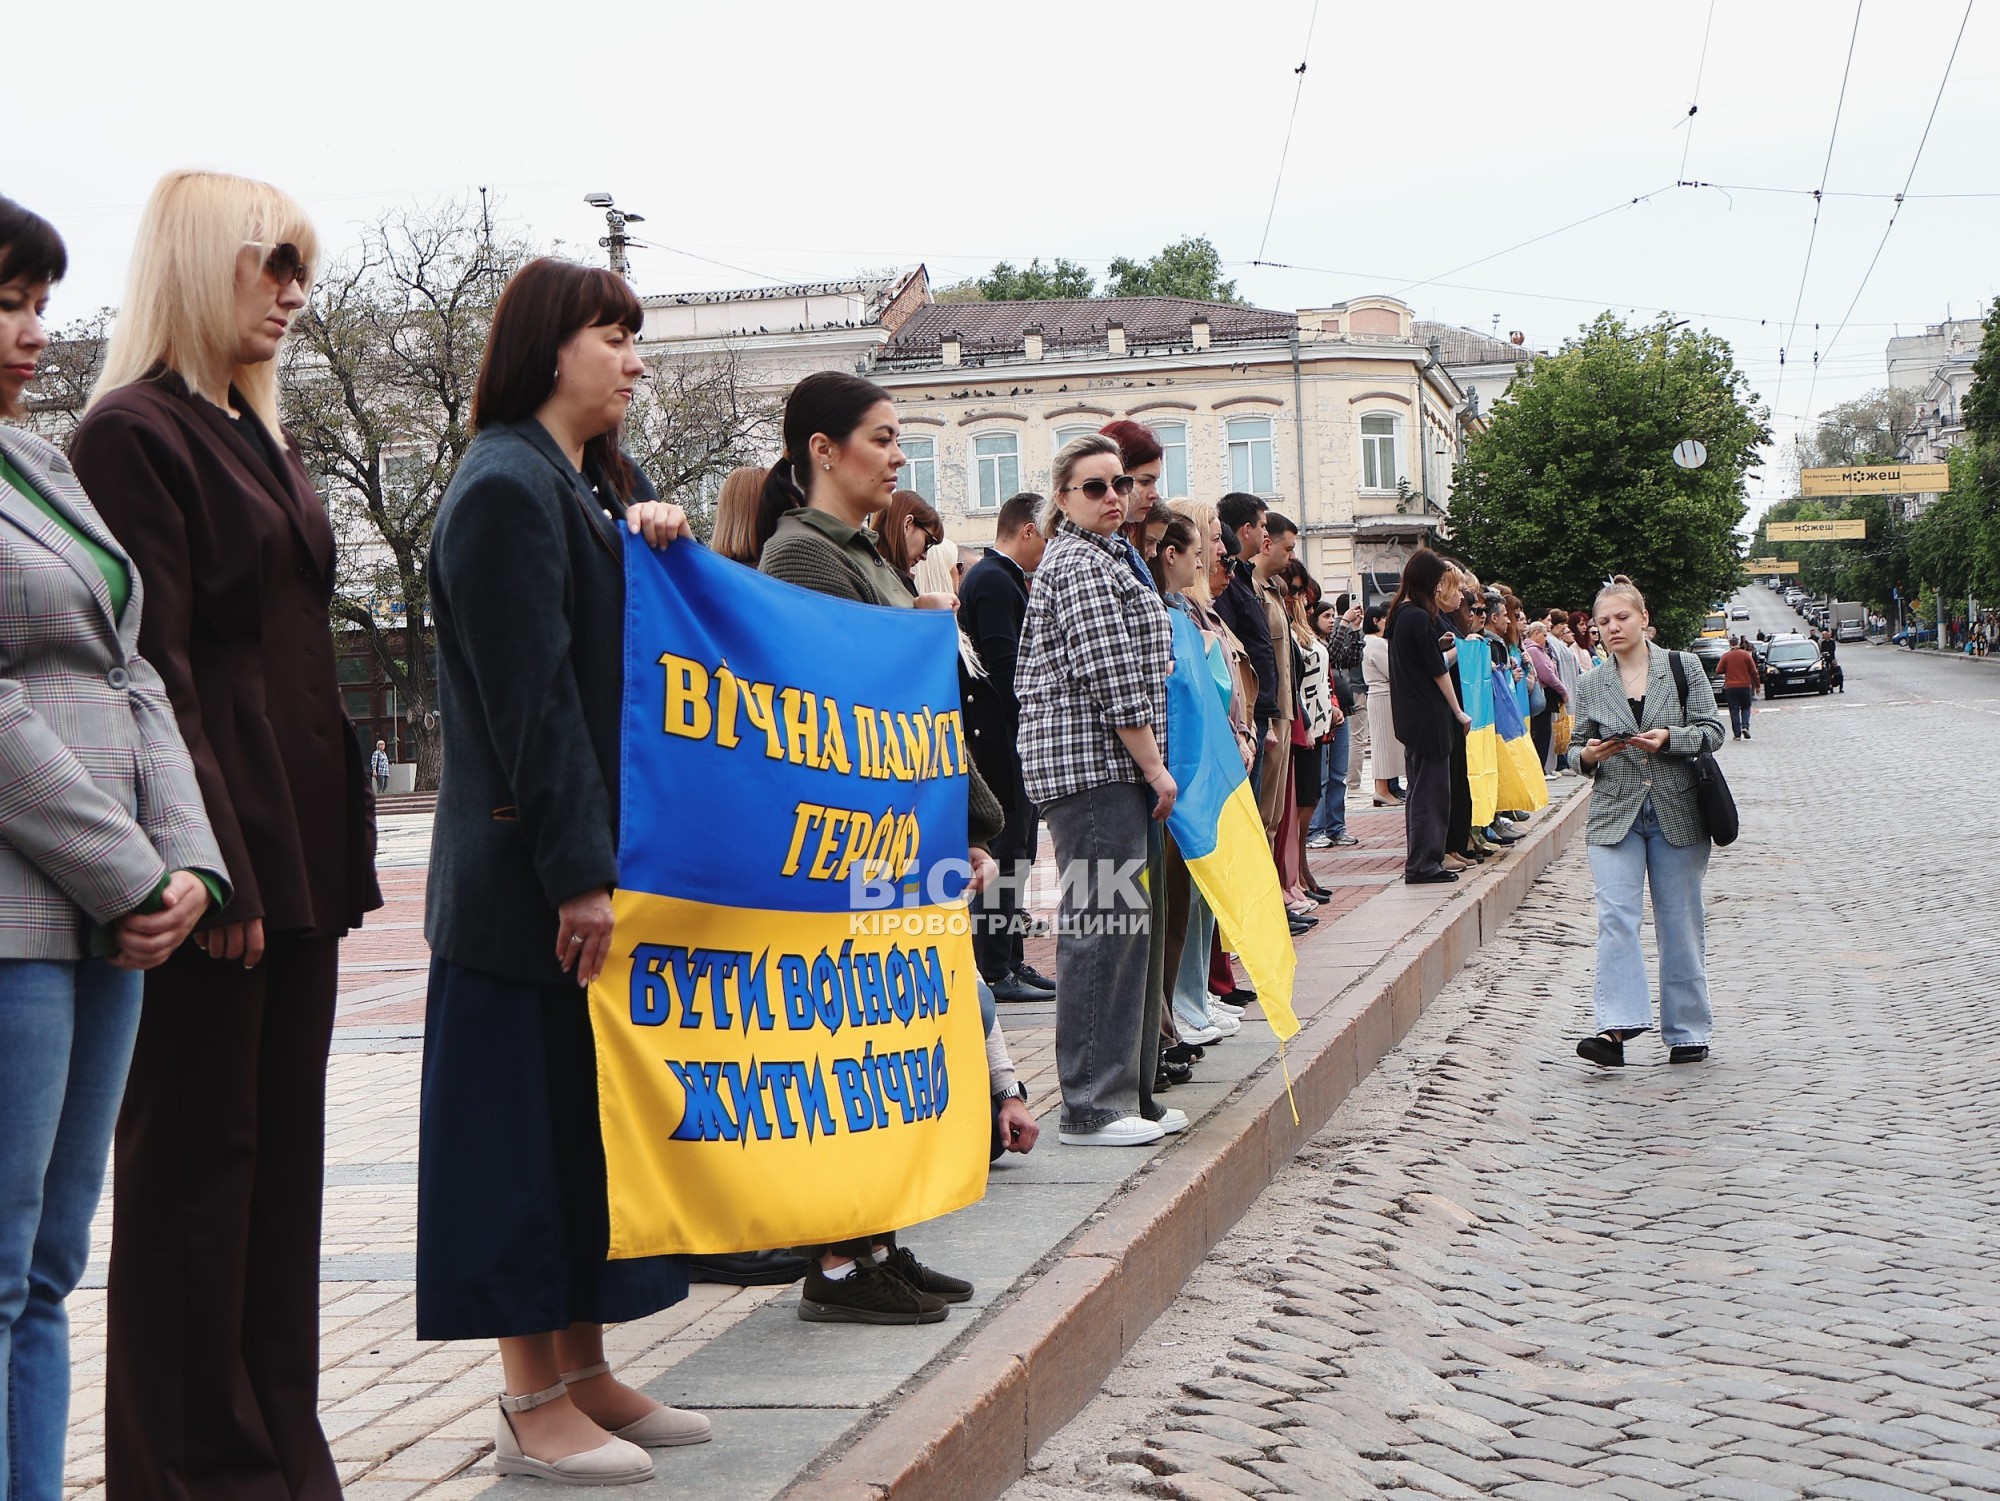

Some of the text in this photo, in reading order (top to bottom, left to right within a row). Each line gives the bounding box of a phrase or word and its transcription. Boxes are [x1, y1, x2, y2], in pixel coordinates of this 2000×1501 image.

[1842, 471, 1900, 483] можеш
[658, 651, 852, 775] ВІЧНА
[780, 802, 920, 884] ГЕРОЮ
[628, 942, 775, 1039] БУТИ
[664, 1034, 949, 1150] ЖИТИ ВІЧНО
